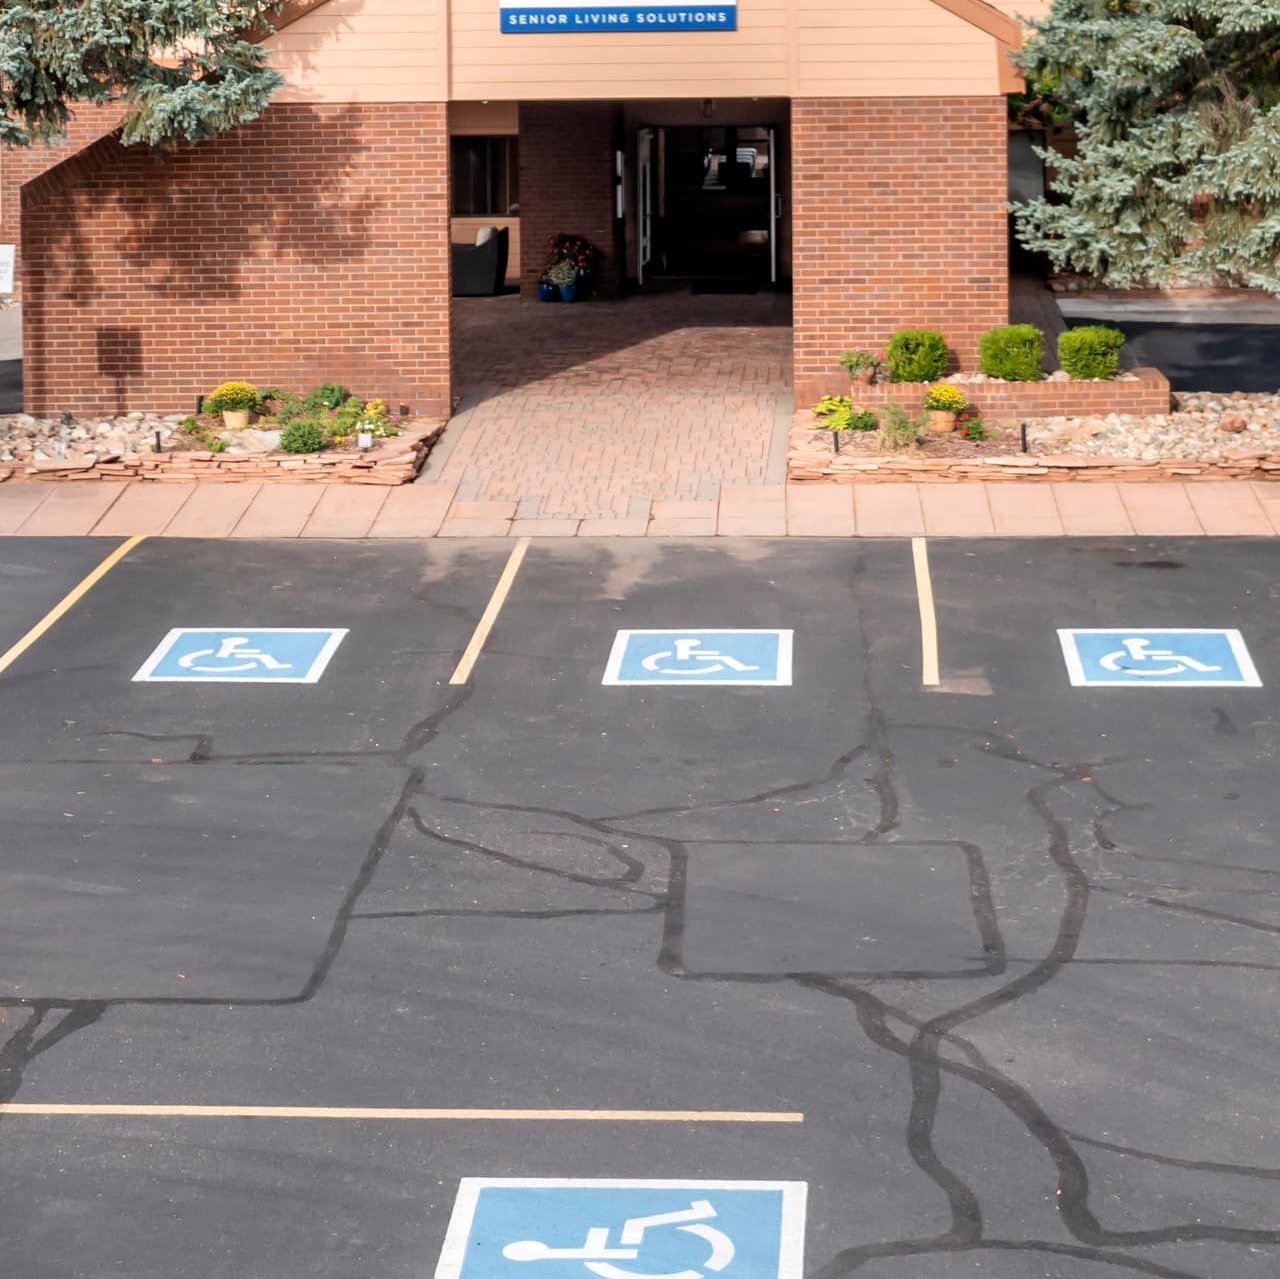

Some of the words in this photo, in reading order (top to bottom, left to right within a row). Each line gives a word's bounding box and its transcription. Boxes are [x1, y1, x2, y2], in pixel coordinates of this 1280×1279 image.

[509, 14, 568, 25] SENIOR
[575, 13, 629, 24] LIVING
[636, 12, 727, 23] SOLUTIONS
